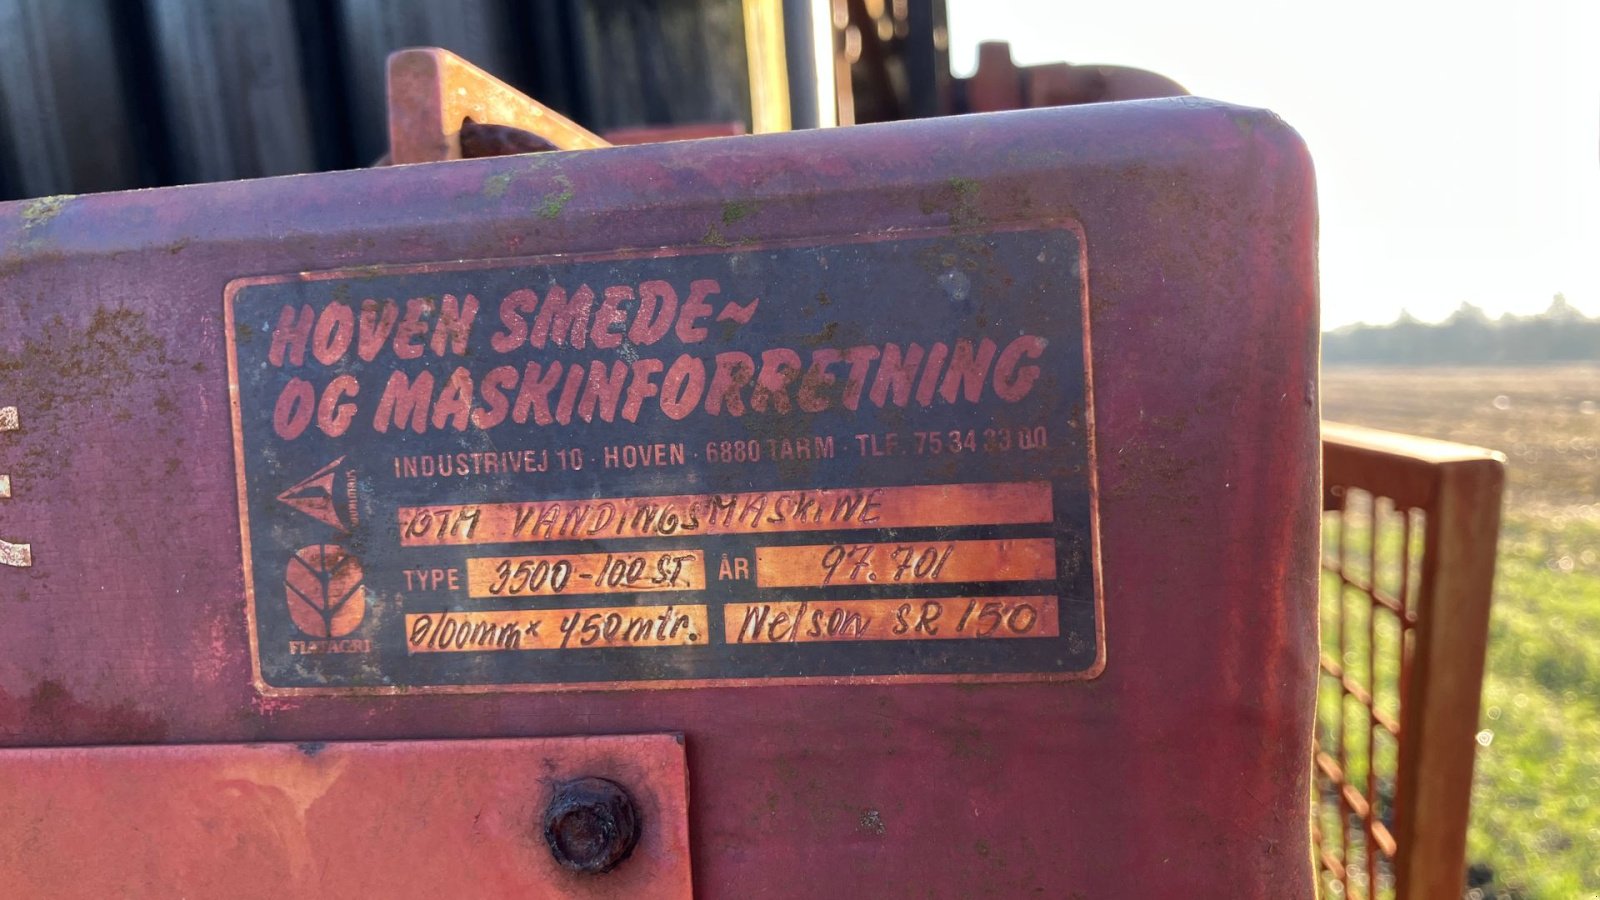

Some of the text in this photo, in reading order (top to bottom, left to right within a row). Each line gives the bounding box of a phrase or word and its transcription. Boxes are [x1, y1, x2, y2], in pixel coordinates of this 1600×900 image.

[268, 294, 479, 367] HOVEN
[273, 334, 1049, 440] OG MASKINFORRETNING
[394, 450, 548, 478] INDUSTRIVEJ
[557, 448, 583, 471] 10
[604, 443, 685, 469] HOVEN
[706, 438, 760, 463] 6880
[770, 436, 834, 461] TARM
[403, 568, 459, 592] TYPE
[718, 552, 749, 581] ÅR
[737, 599, 1037, 642] Nelson SR 150
